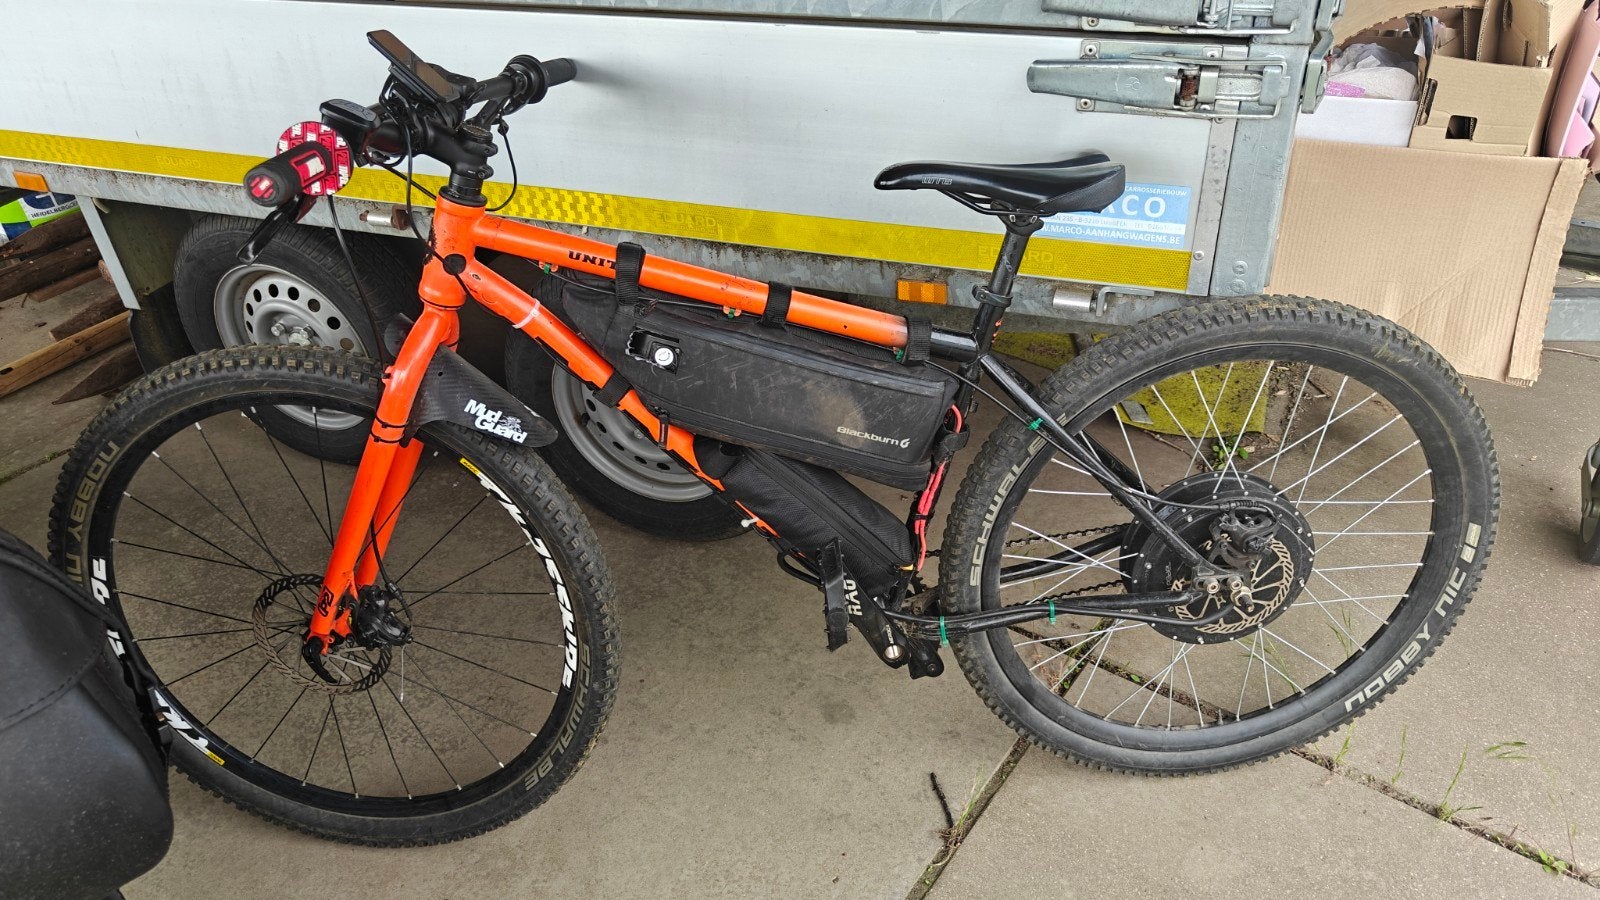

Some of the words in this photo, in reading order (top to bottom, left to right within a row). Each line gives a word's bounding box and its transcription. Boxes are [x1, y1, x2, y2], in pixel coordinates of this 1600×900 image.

[464, 399, 503, 424] Mud
[475, 415, 529, 444] Guard
[836, 426, 900, 446] Blackburn
[67, 440, 121, 543] NOBBY
[1343, 622, 1431, 713] NOBBY
[1434, 567, 1467, 618] NIC
[524, 642, 591, 792] SCHWALBE
